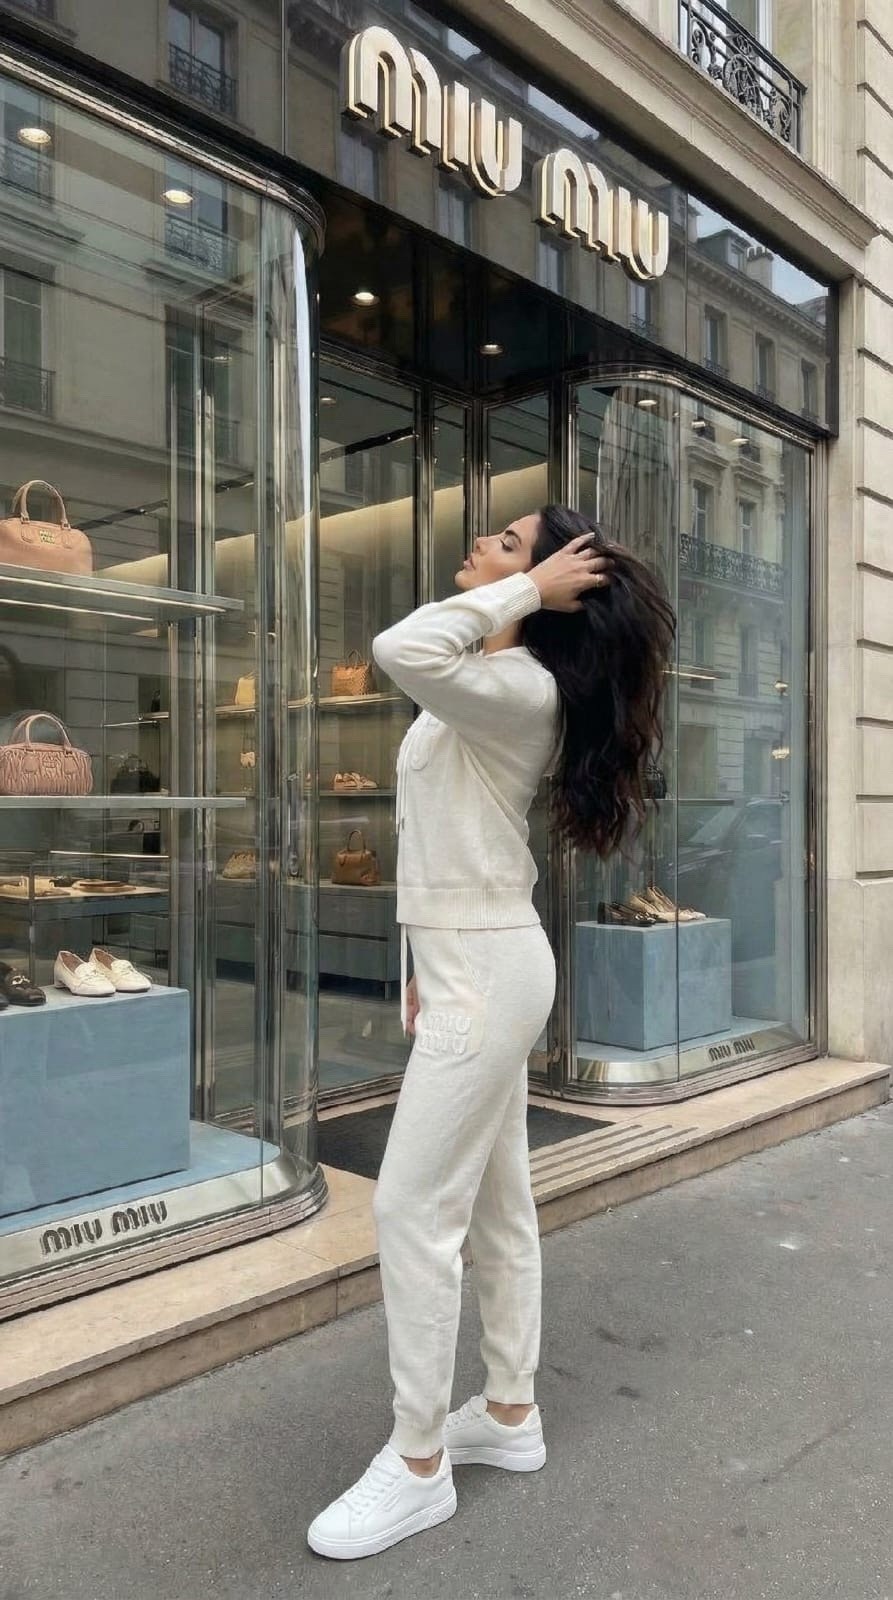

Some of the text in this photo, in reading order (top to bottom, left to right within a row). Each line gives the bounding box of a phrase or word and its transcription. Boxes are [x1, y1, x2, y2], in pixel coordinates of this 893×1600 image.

[342, 26, 669, 280] MIU MIU
[40, 1200, 168, 1254] MIU MIU
